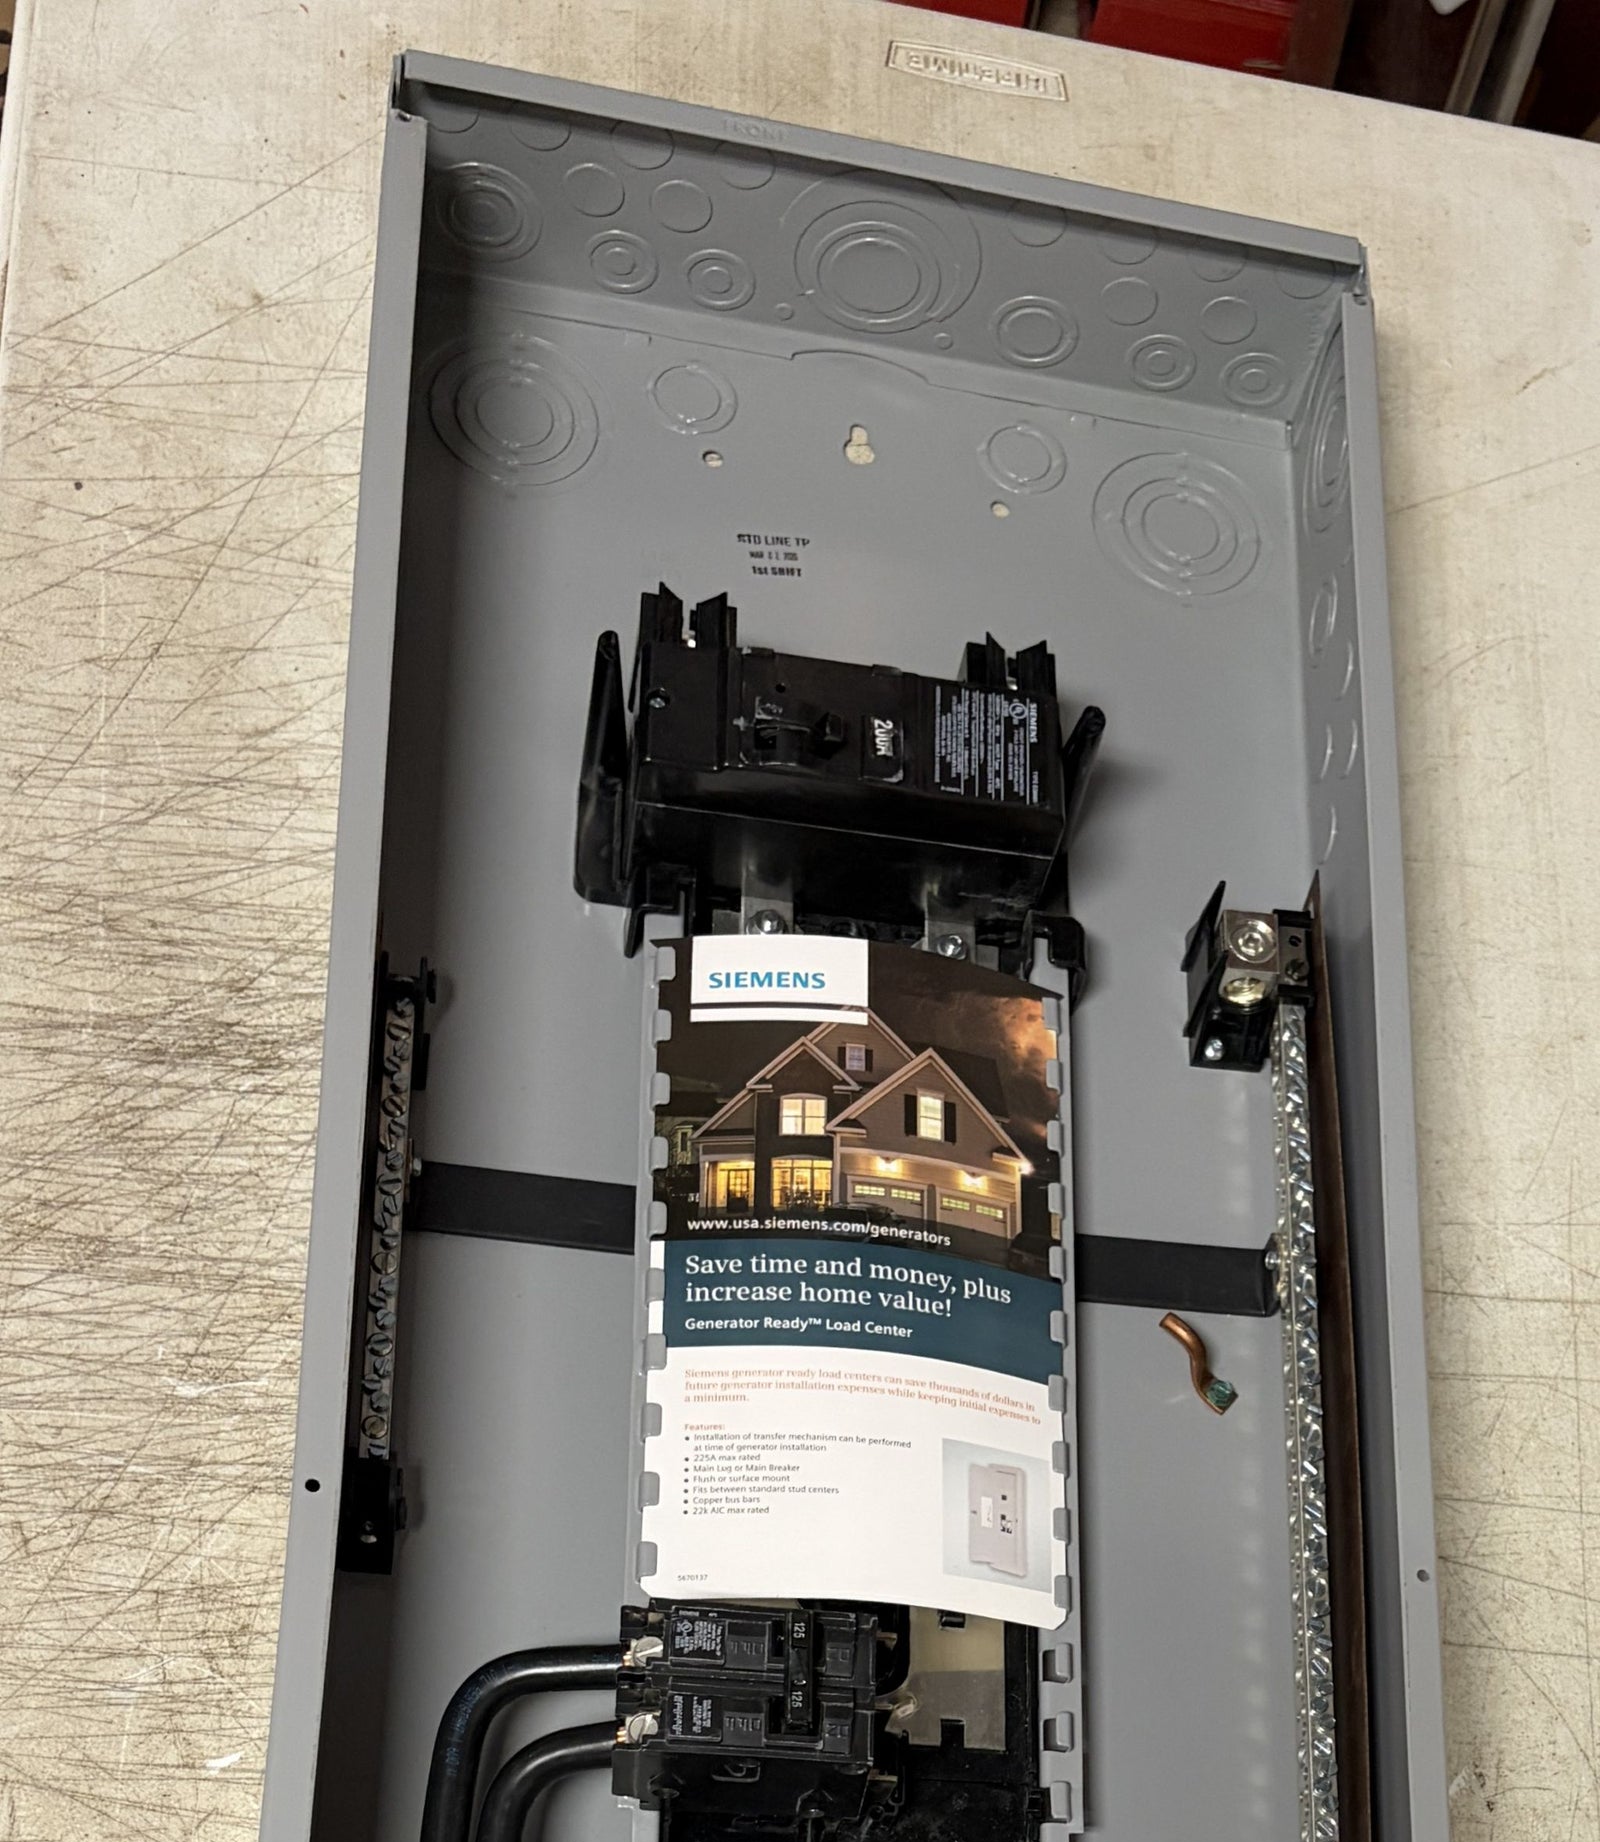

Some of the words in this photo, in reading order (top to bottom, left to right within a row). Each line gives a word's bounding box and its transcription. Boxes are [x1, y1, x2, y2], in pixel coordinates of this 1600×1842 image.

[1030, 702, 1038, 743] SIEMENS
[708, 971, 825, 989] SIEMENS
[687, 1216, 950, 1245] www.usa.siemens.com/generators
[685, 1254, 742, 1274] Save
[749, 1253, 807, 1273] time
[814, 1256, 862, 1276] and
[869, 1263, 956, 1294] money,
[963, 1277, 1010, 1303] plus
[685, 1282, 792, 1302] increase
[799, 1281, 871, 1305] home
[877, 1290, 950, 1317] value!
[684, 1317, 759, 1330] Generator
[825, 1318, 860, 1332] Load
[864, 1321, 912, 1337] Center
[693, 1453, 716, 1462] 225A
[737, 1452, 760, 1461] rated
[692, 1474, 716, 1482] Flush
[728, 1474, 759, 1482] surface
[761, 1474, 790, 1482] mount
[793, 1622, 806, 1639] 125
